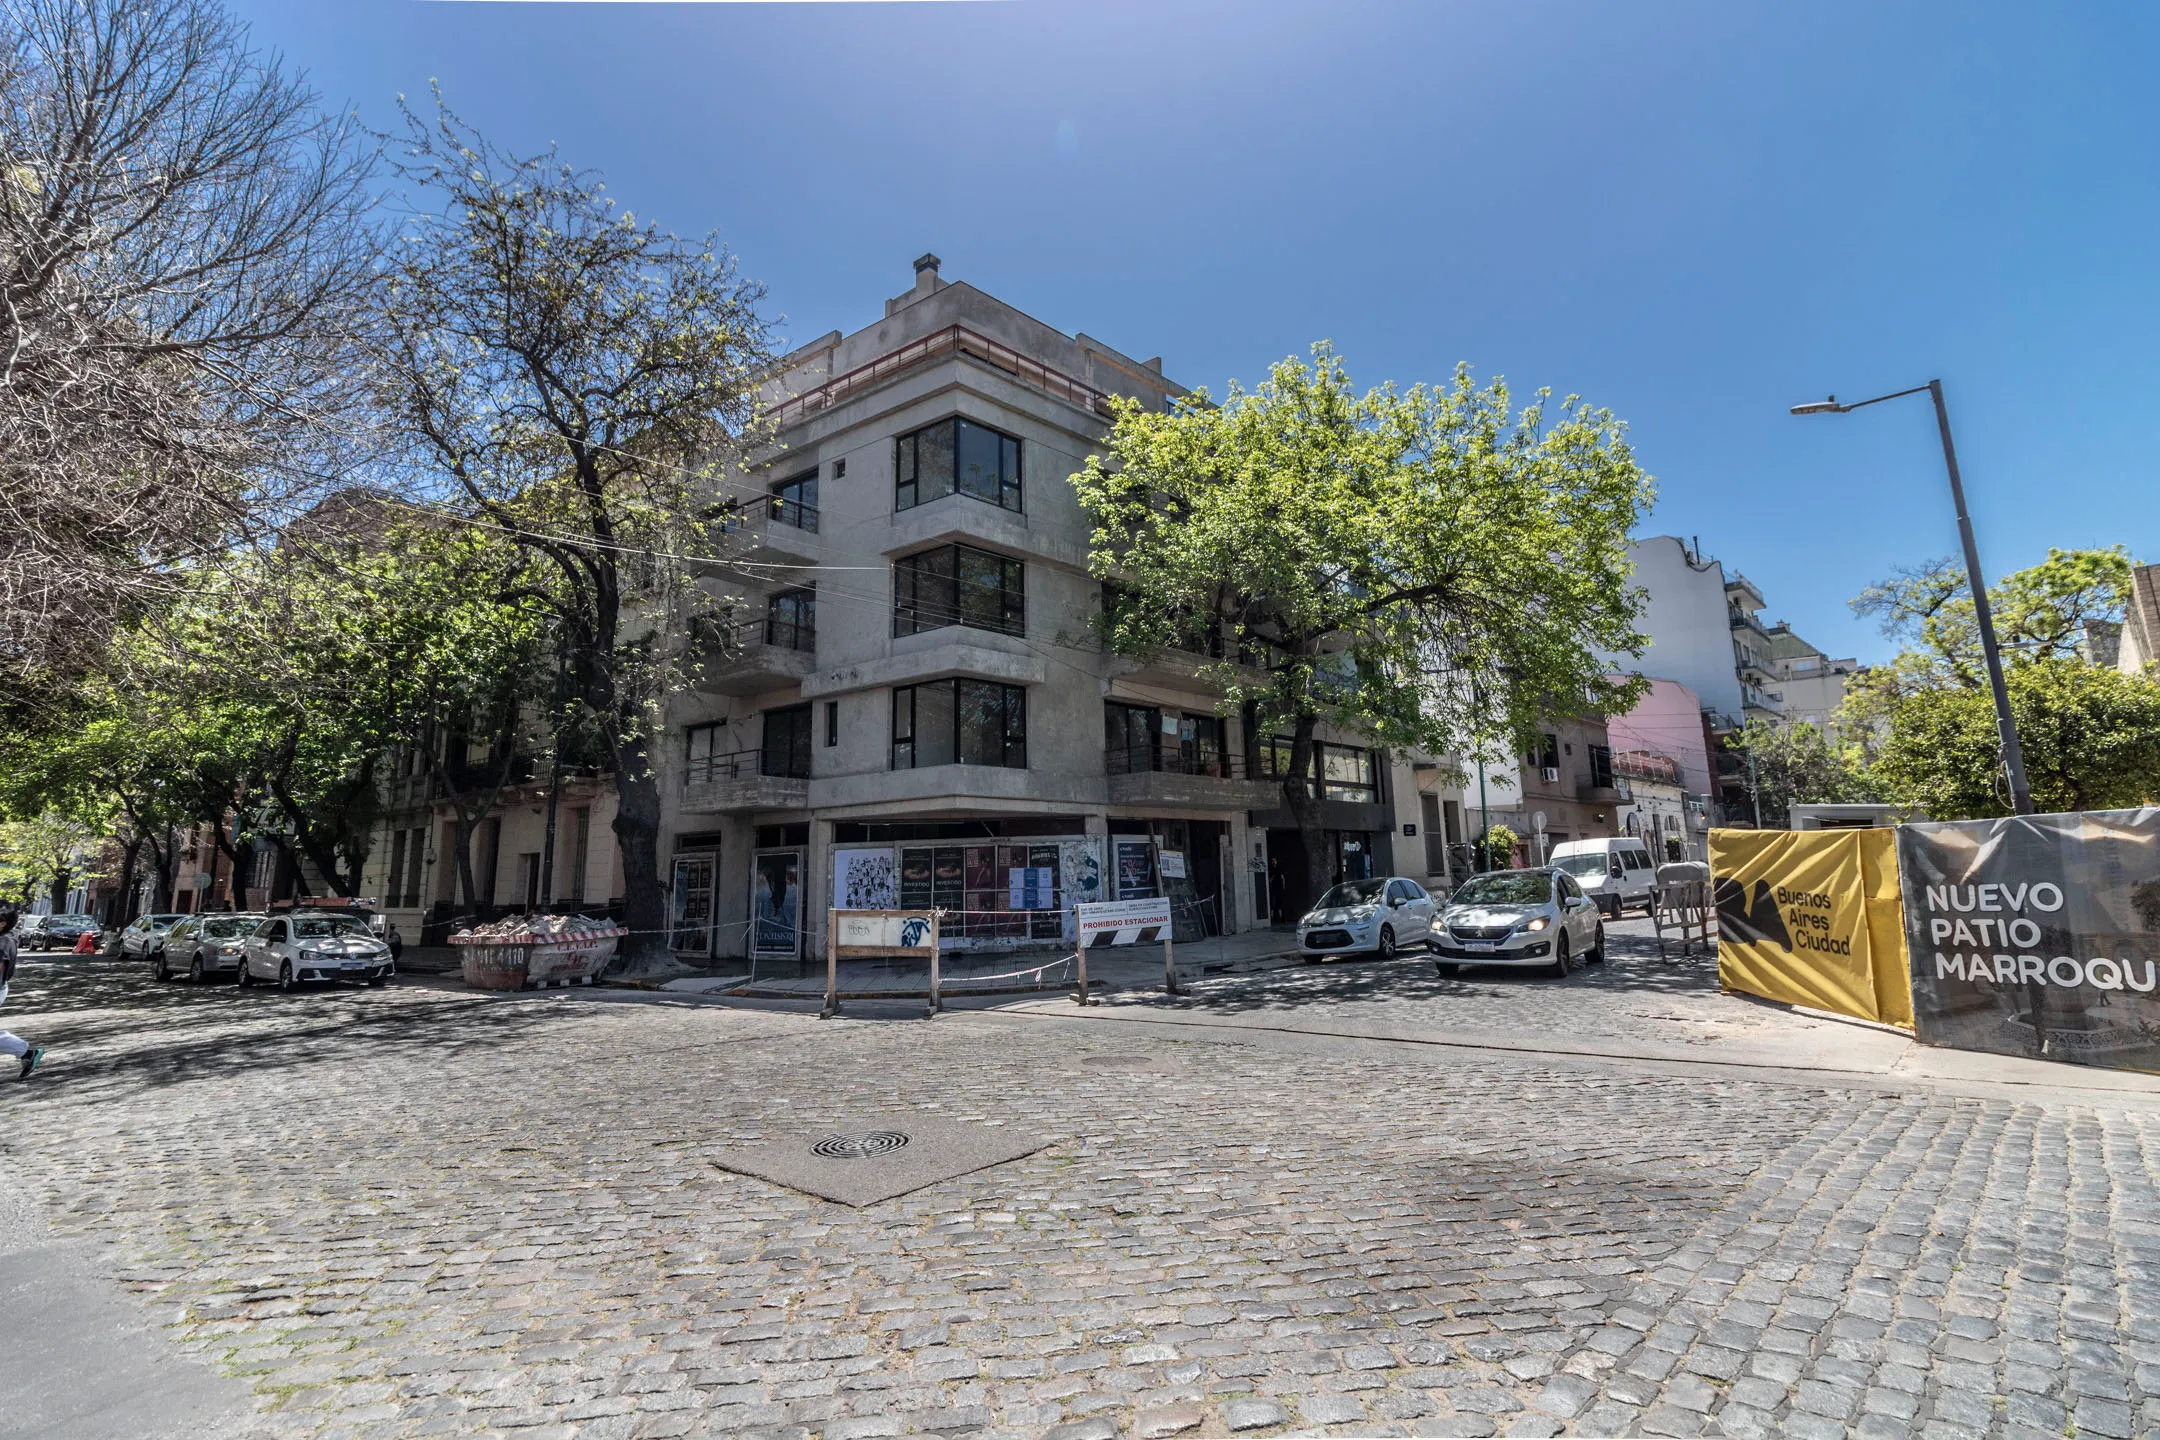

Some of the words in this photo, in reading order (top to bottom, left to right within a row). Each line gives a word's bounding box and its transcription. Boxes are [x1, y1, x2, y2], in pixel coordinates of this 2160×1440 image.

[1777, 885, 1832, 910] Buenos
[1926, 882, 2064, 913] NUEVO
[1083, 919, 1123, 929] PROHIBIDO
[1125, 915, 1168, 926] ESTACIONAR
[1789, 907, 1830, 931] Aires
[1795, 929, 1851, 957] Ciudad
[1930, 918, 2042, 949] PATIO
[1935, 952, 2156, 992] MARROQU
